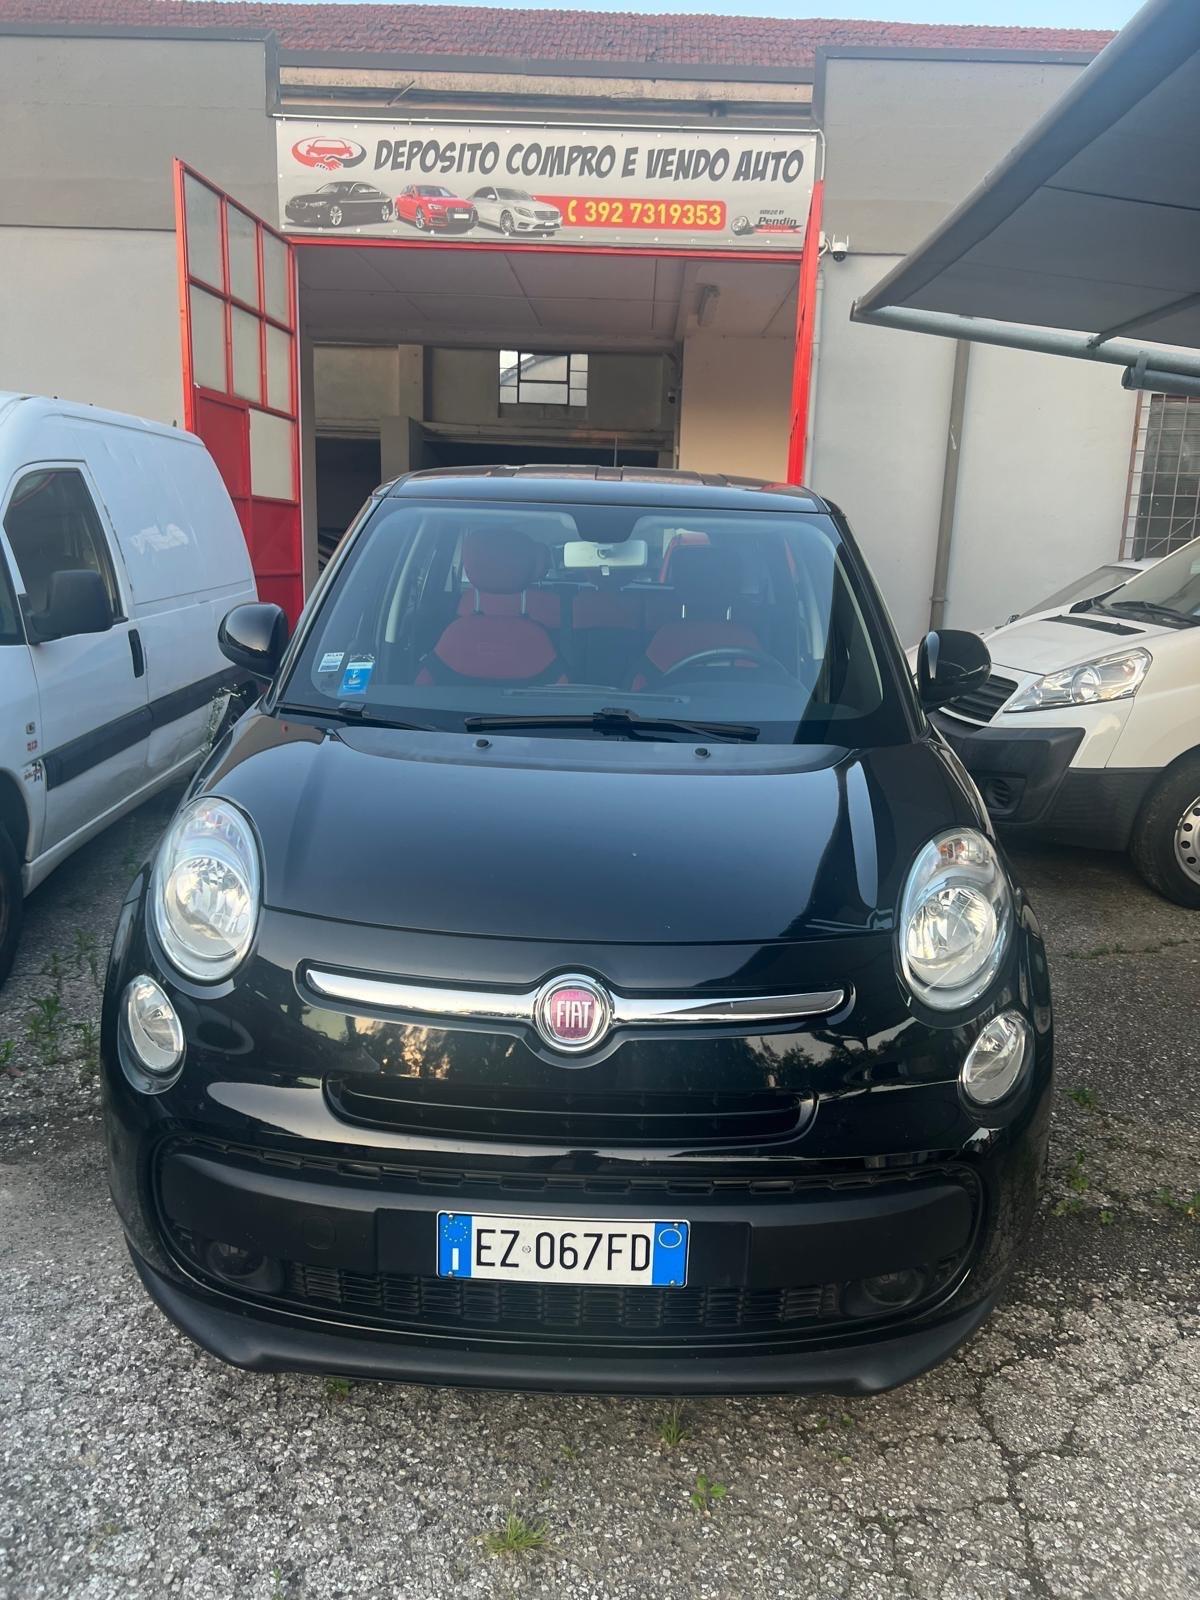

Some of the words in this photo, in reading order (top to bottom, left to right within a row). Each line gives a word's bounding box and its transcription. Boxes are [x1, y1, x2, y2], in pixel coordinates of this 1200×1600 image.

[374, 139, 500, 175] DEPOSITO
[506, 142, 616, 179] COMPRO
[621, 146, 639, 178] E
[645, 147, 730, 182] VENDO
[732, 149, 804, 183] AUTO
[584, 201, 623, 223] 392
[630, 202, 721, 226] 7319353
[556, 1000, 592, 1028] FIAT
[475, 1228, 520, 1268] EZ
[535, 1231, 651, 1272] 067FD
